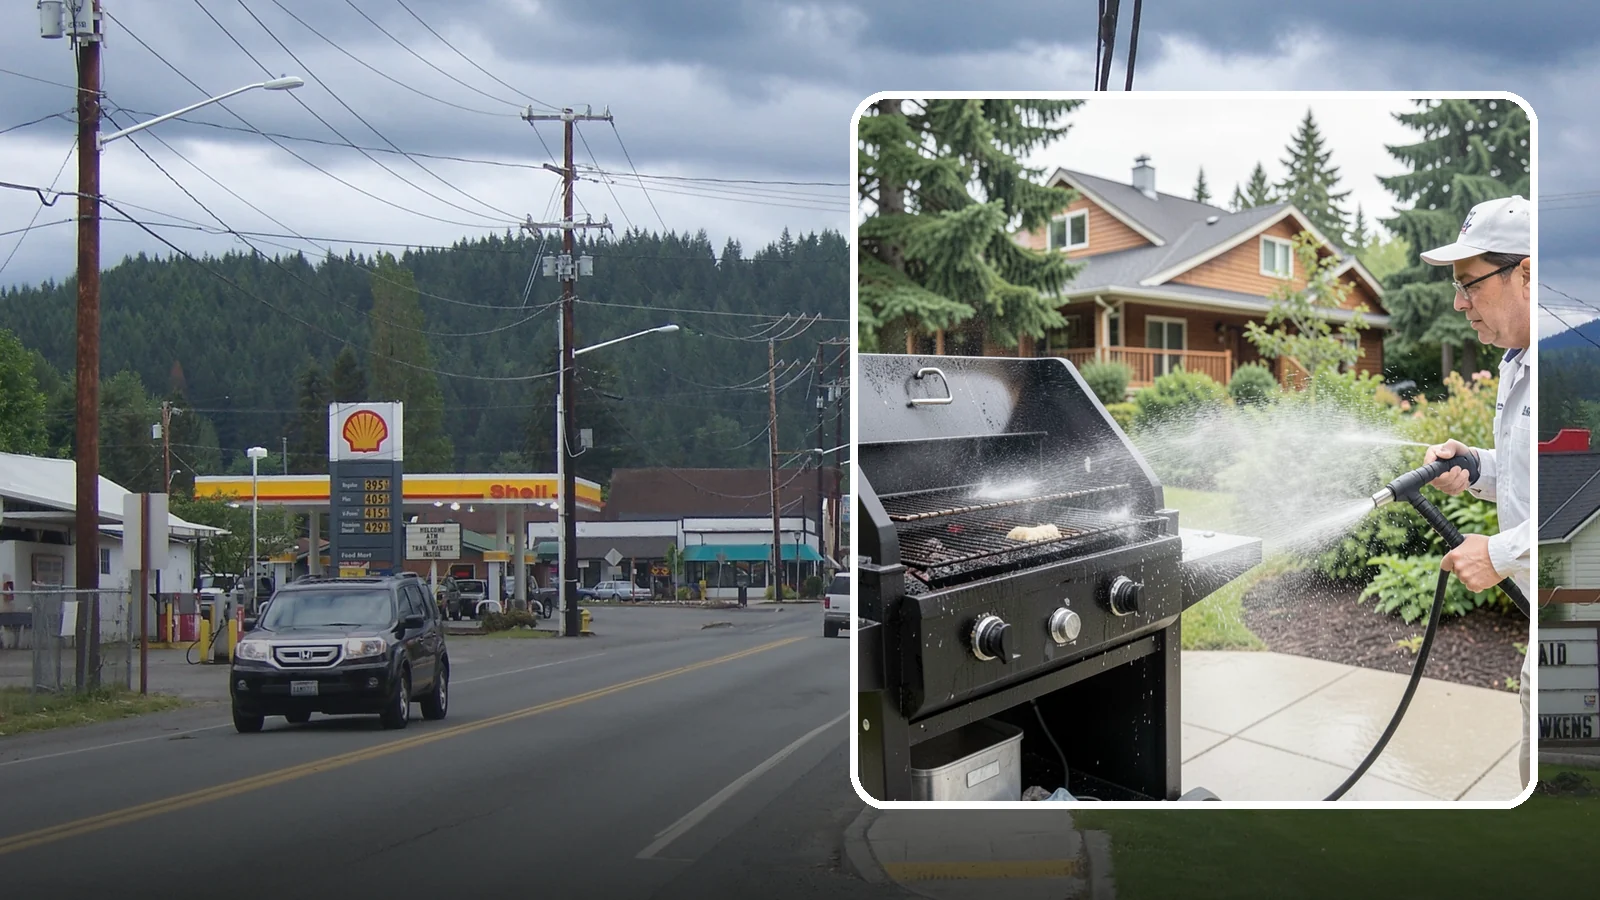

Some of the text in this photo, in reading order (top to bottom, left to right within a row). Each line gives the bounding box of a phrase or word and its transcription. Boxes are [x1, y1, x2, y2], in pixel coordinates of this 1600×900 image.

[365, 480, 383, 490] 395
[490, 484, 547, 499] Shell
[365, 494, 383, 504] 405
[365, 508, 383, 518] 415
[366, 522, 383, 532] 429
